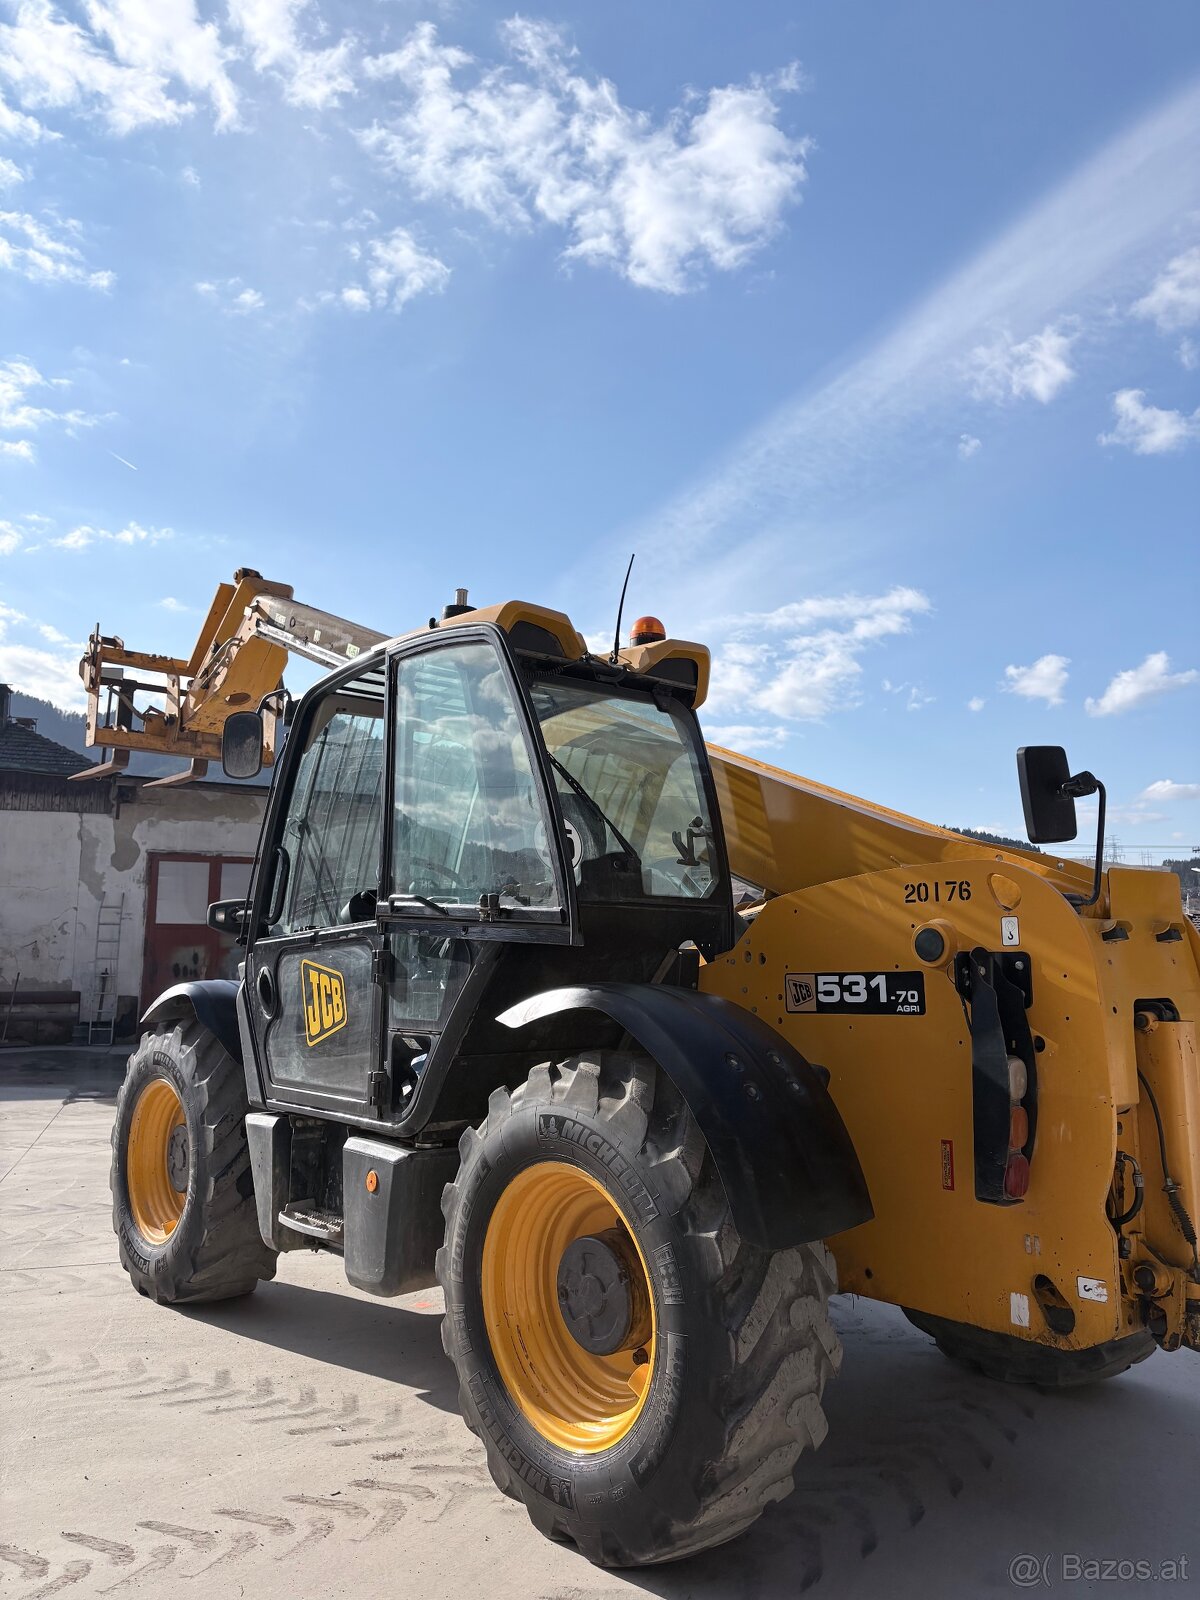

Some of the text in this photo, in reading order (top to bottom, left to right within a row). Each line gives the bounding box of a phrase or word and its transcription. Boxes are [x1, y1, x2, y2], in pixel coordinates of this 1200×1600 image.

[904, 880, 972, 903] 20176
[308, 969, 343, 1037] JCB
[793, 981, 812, 1004] JCB
[896, 1005, 920, 1013] AGRI
[560, 1119, 659, 1223] MICHELIN
